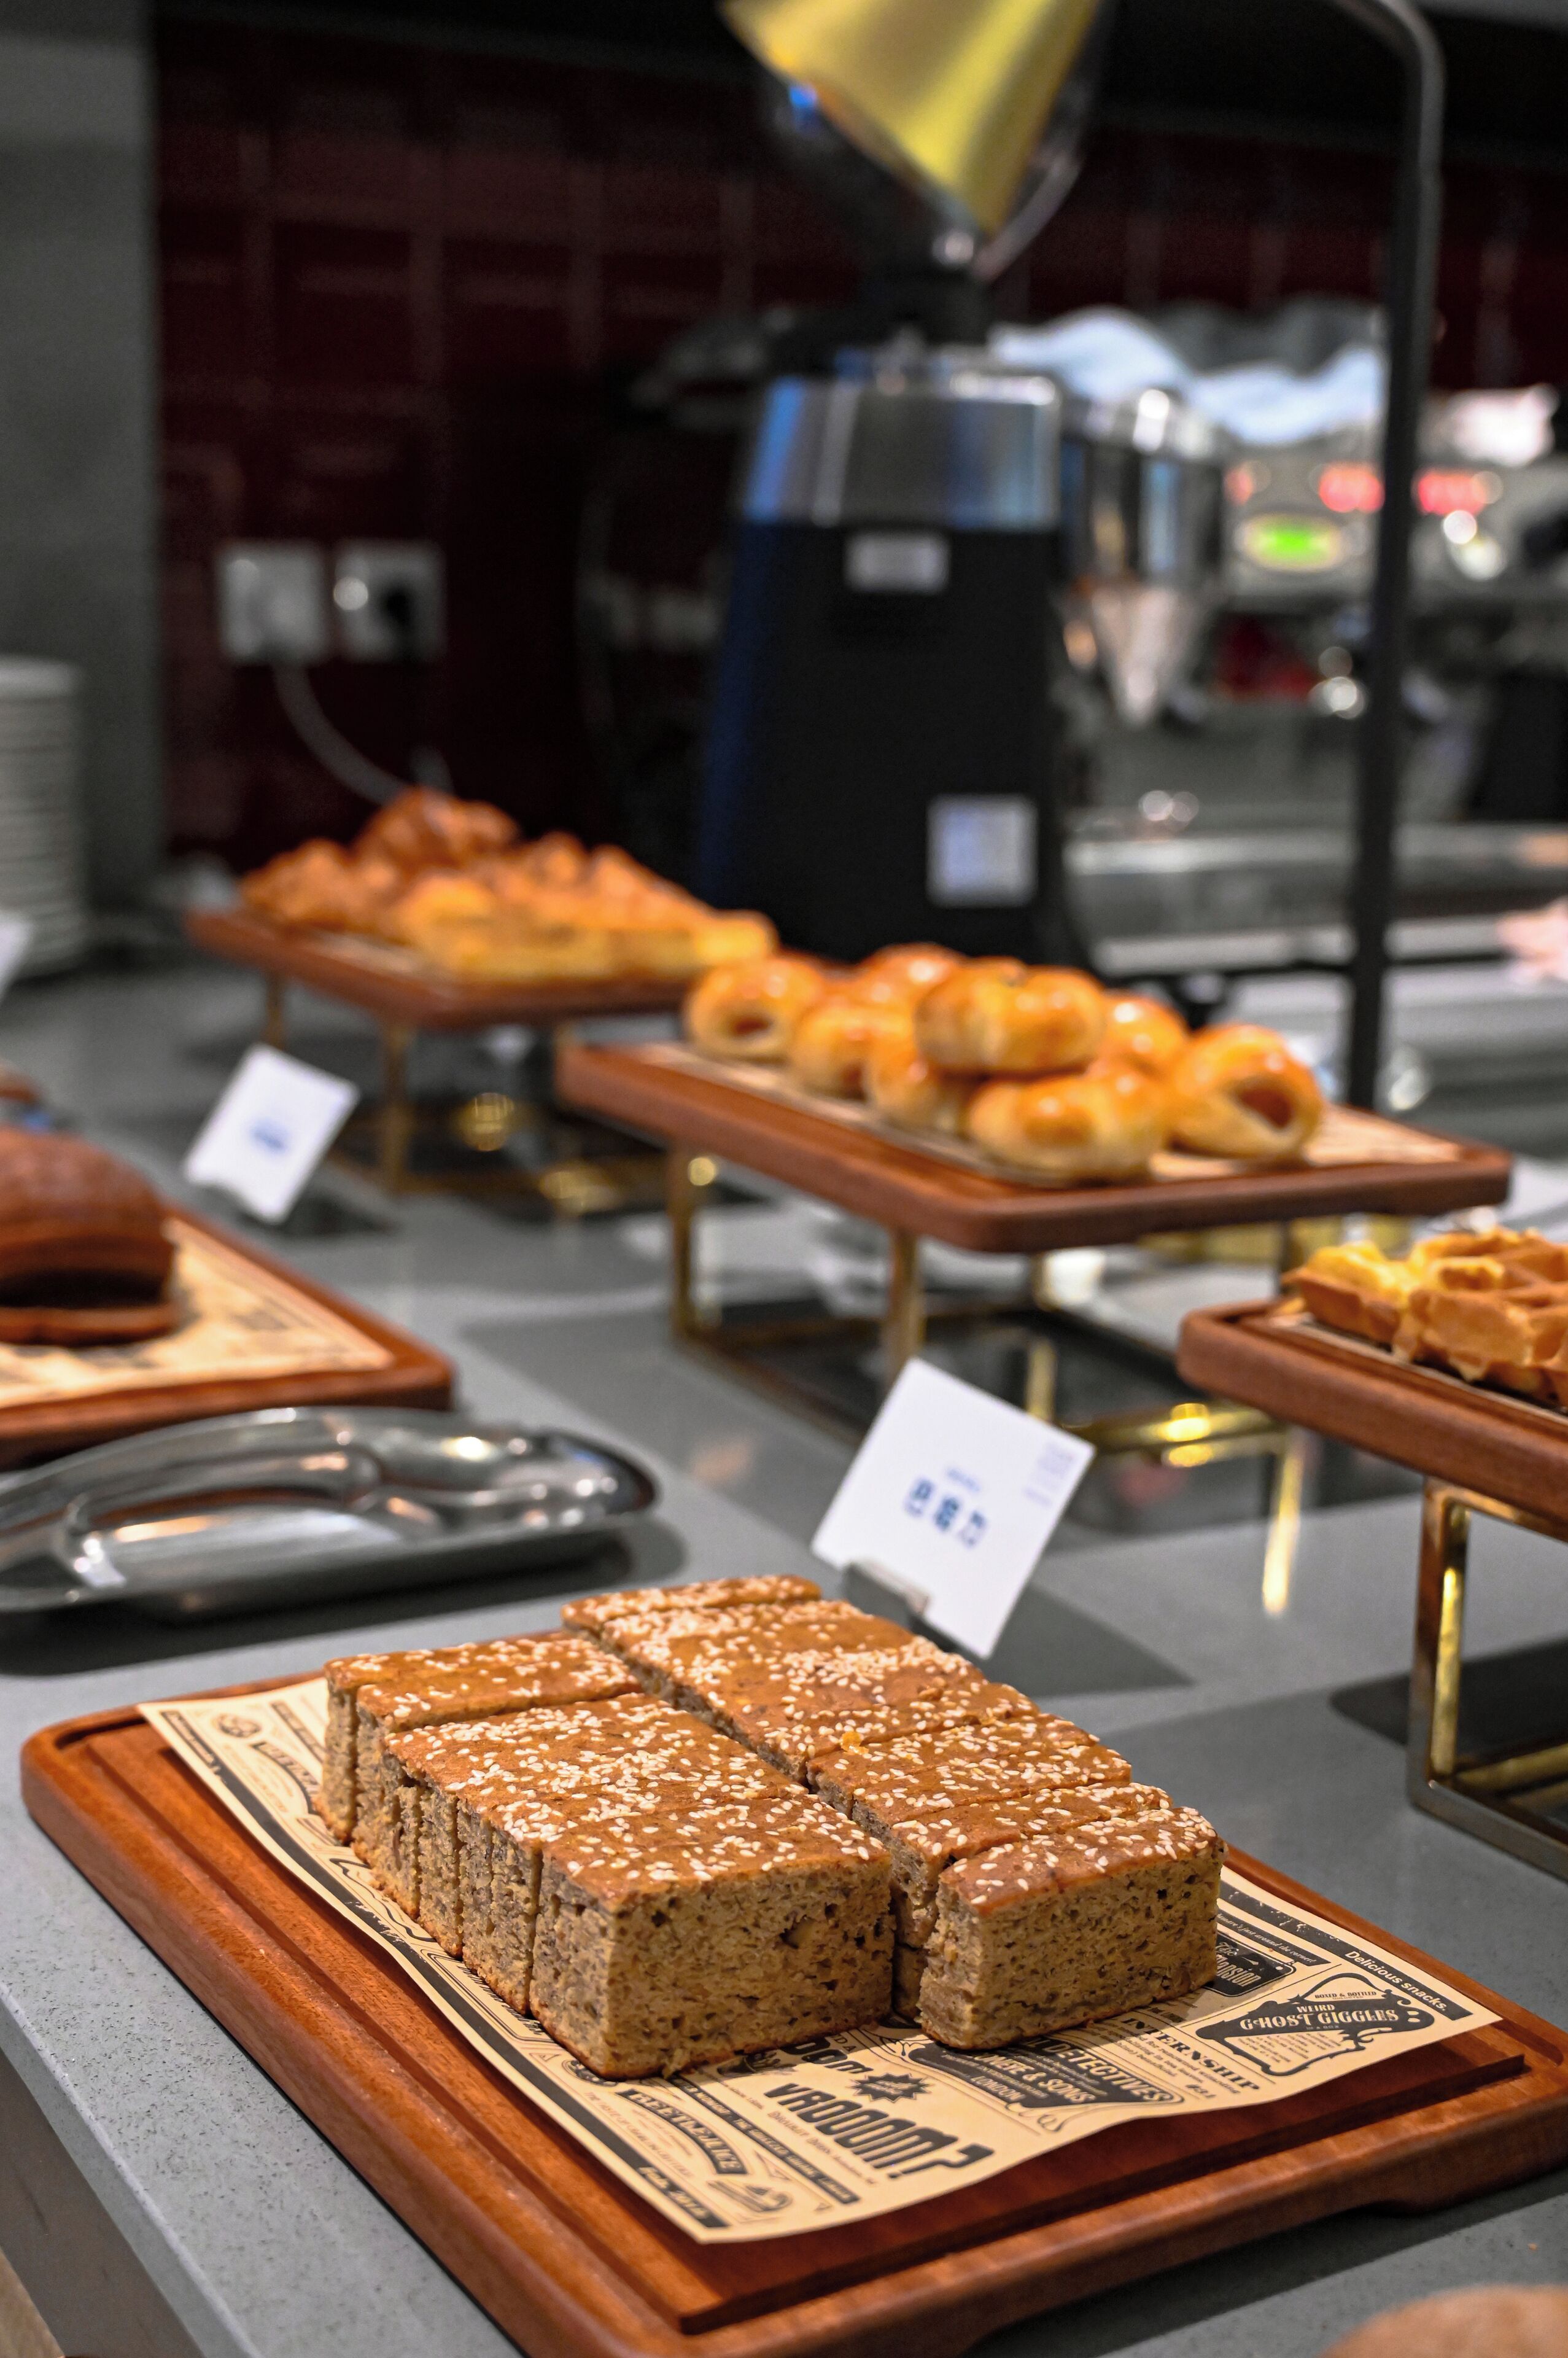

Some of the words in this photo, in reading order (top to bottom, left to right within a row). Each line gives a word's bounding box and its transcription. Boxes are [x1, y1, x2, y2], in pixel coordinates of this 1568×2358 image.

[1240, 1926, 1257, 1936] just
[1255, 1934, 1281, 1948] around
[1279, 1943, 1290, 1952] the
[1290, 1951, 1318, 1963] corner!
[1345, 1951, 1403, 1984] Delicious
[1401, 1982, 1448, 2012] snacks.
[1240, 2013, 1314, 2031] GHOST
[1318, 2009, 1399, 2025] GIGGLES
[1297, 2004, 1335, 2013] WEIRD
[1042, 2042, 1172, 2101] DETECTIVES
[1121, 2018, 1260, 2090] INTERNSHIP
[1022, 2072, 1047, 2082] &
[1038, 2078, 1097, 2104] SONS
